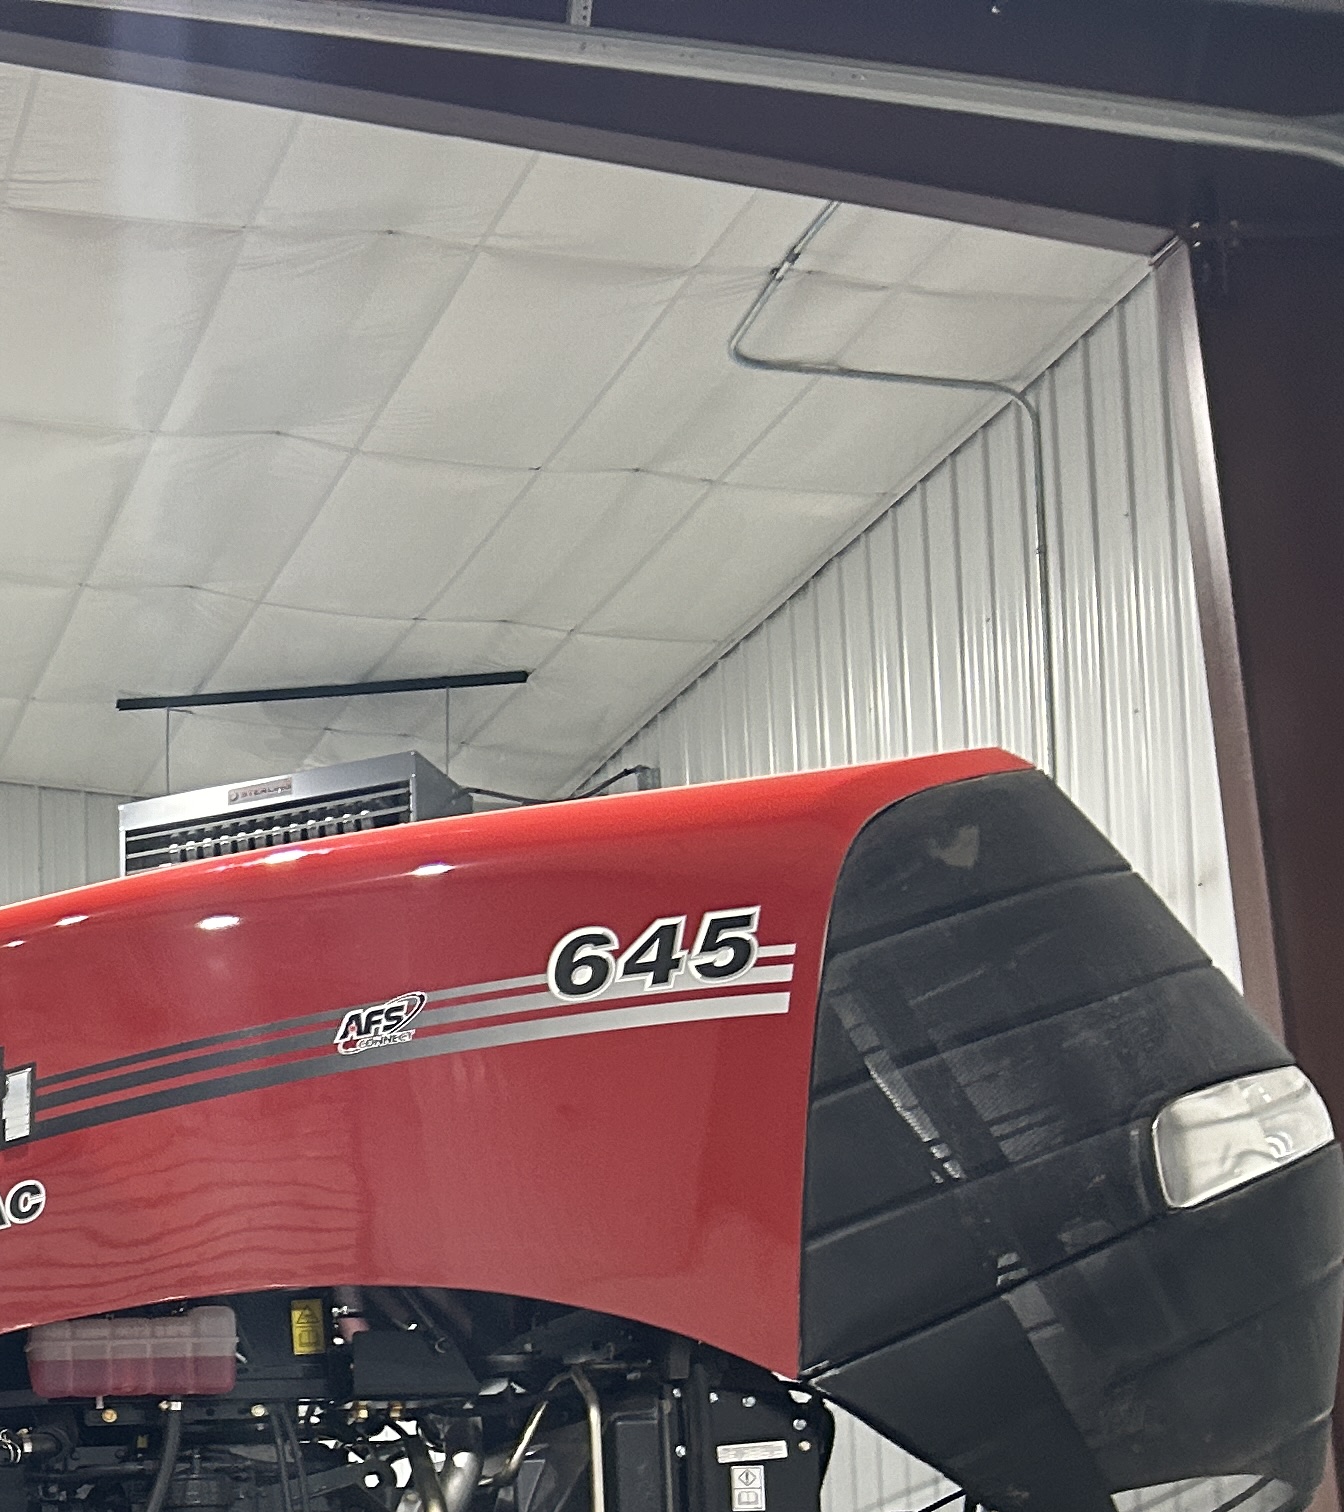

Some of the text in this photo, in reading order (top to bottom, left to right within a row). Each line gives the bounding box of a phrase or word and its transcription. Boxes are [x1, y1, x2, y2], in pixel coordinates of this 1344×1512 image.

[547, 905, 762, 1001] 645
[335, 1001, 409, 1042] AFS
[357, 1030, 415, 1048] CONNECT
